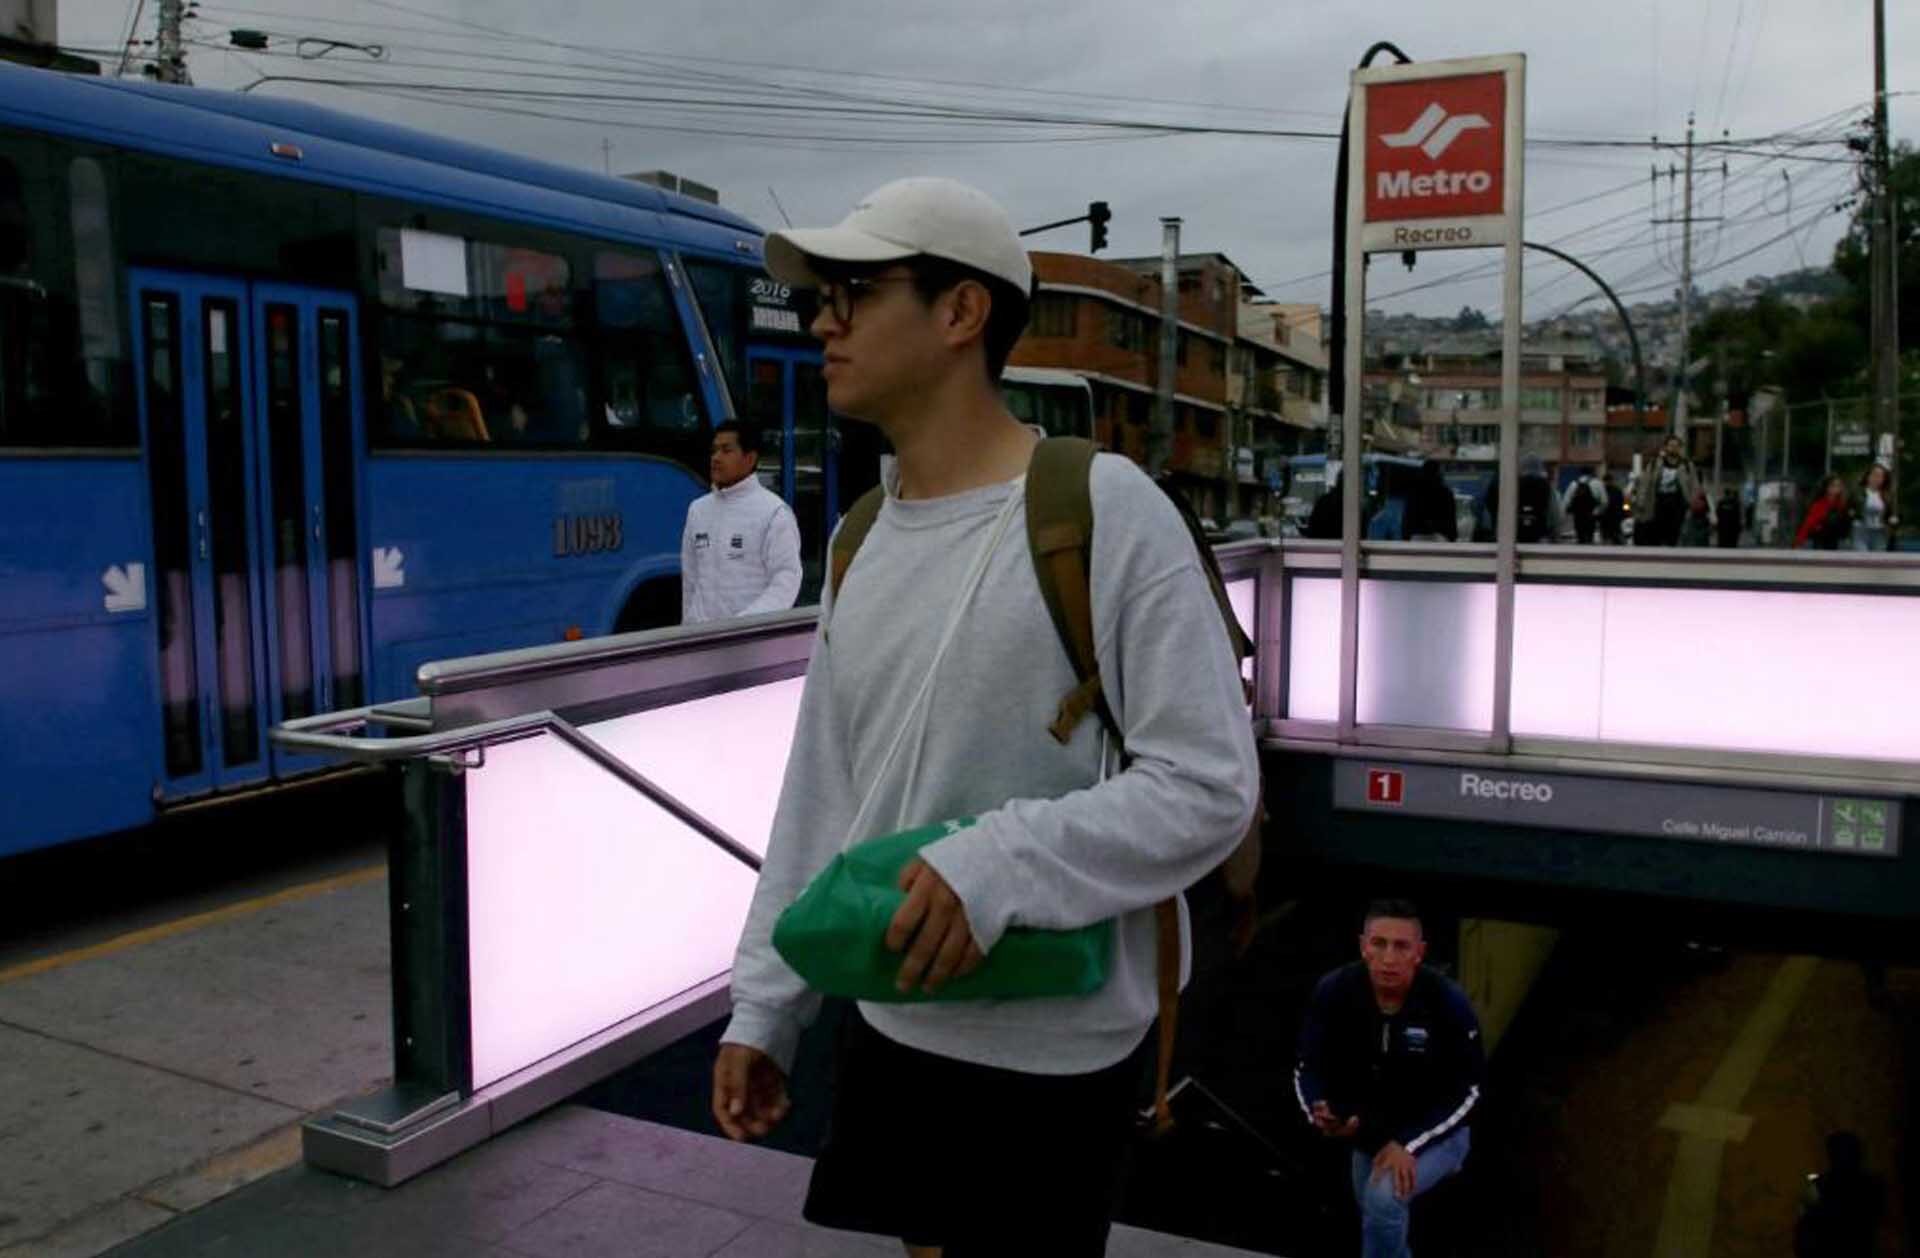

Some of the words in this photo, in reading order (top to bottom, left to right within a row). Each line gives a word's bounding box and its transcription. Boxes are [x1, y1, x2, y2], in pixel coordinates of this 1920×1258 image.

[1376, 170, 1492, 199] Metro
[1394, 226, 1472, 243] Recreo
[1377, 773, 1391, 799] 1
[1460, 773, 1553, 802] Recreo
[1702, 822, 1750, 841] Miguel
